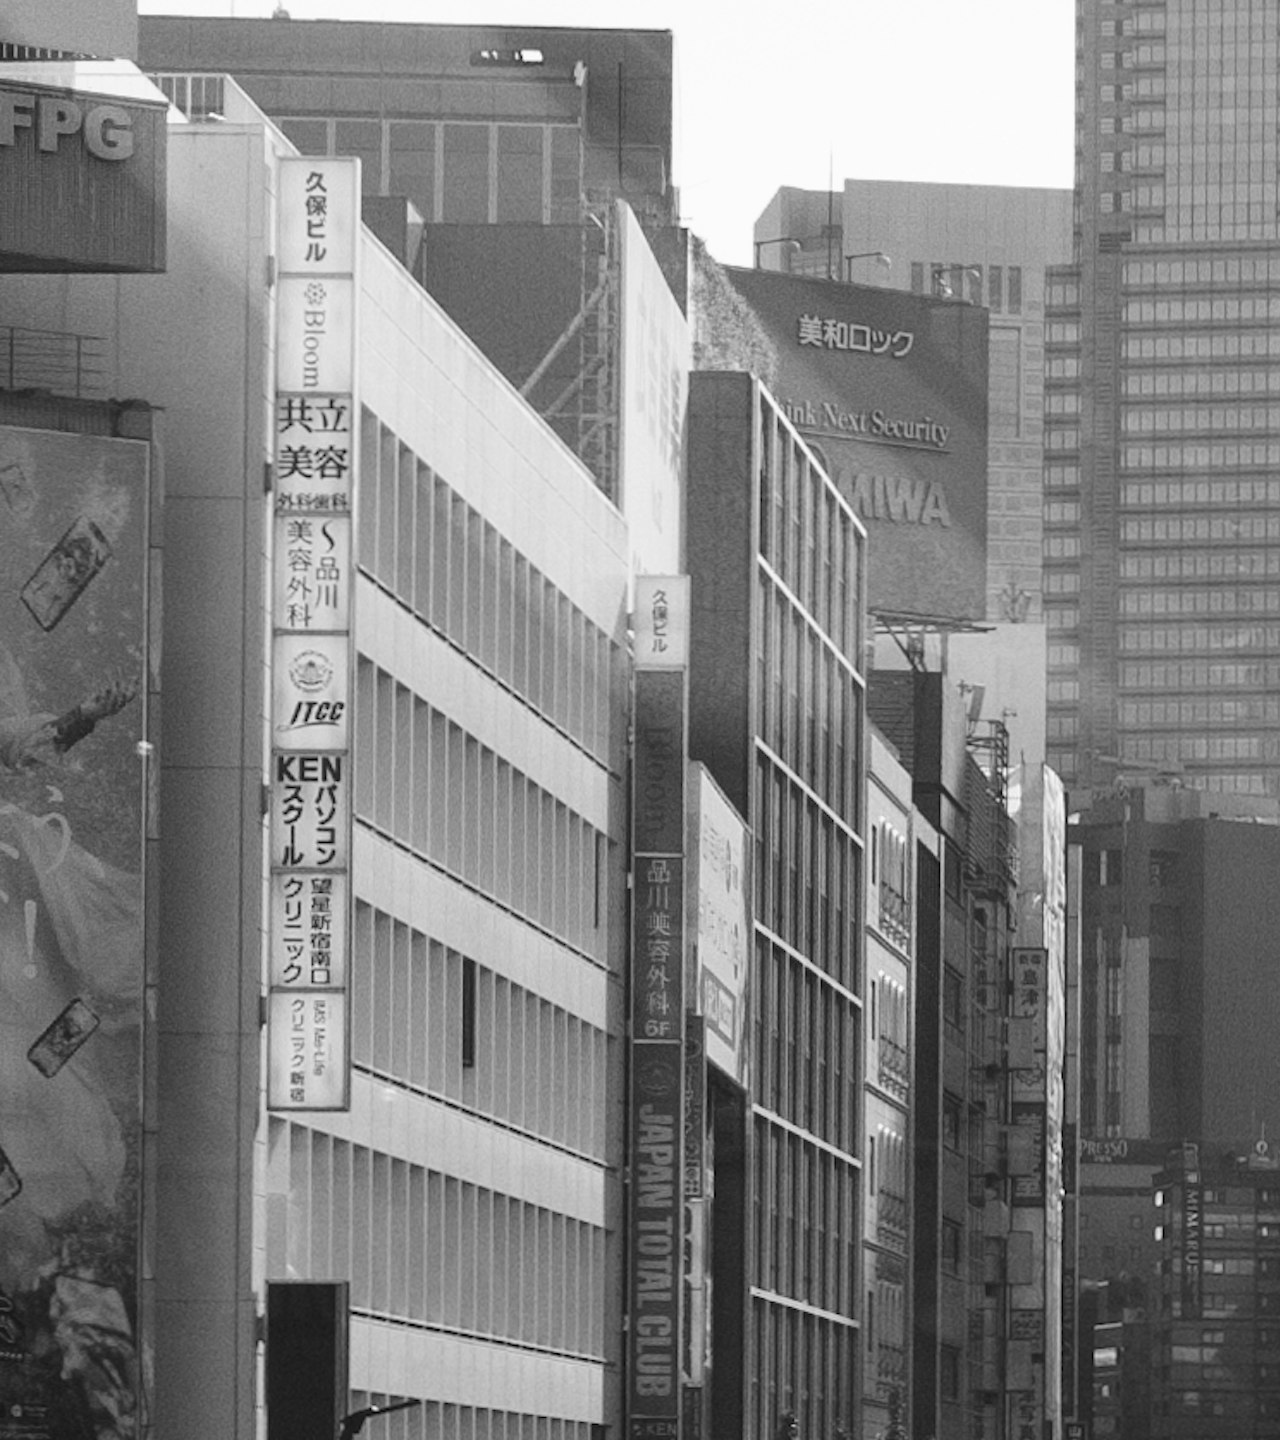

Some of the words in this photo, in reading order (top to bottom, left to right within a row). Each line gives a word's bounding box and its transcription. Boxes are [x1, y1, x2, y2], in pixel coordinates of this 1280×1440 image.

[303, 171, 328, 263] 久保ビル
[302, 310, 326, 388] Bloom
[798, 314, 914, 357] 美和ロック
[277, 398, 348, 434] 共立
[823, 401, 867, 433] Next
[871, 409, 951, 447] Security
[277, 445, 348, 480] 美容
[286, 519, 313, 628] 美容外科
[651, 589, 669, 654] 久保ビル
[277, 755, 342, 783] KEN
[281, 784, 304, 866] スクール
[314, 784, 337, 866] パソコン
[282, 877, 303, 985] クリニック
[645, 860, 673, 1017] 品川美容外科
[645, 1019, 671, 1038] 6F
[637, 1103, 674, 1210] JAPAN
[637, 1216, 674, 1310] TOTAL
[637, 1314, 674, 1398] CLUB
